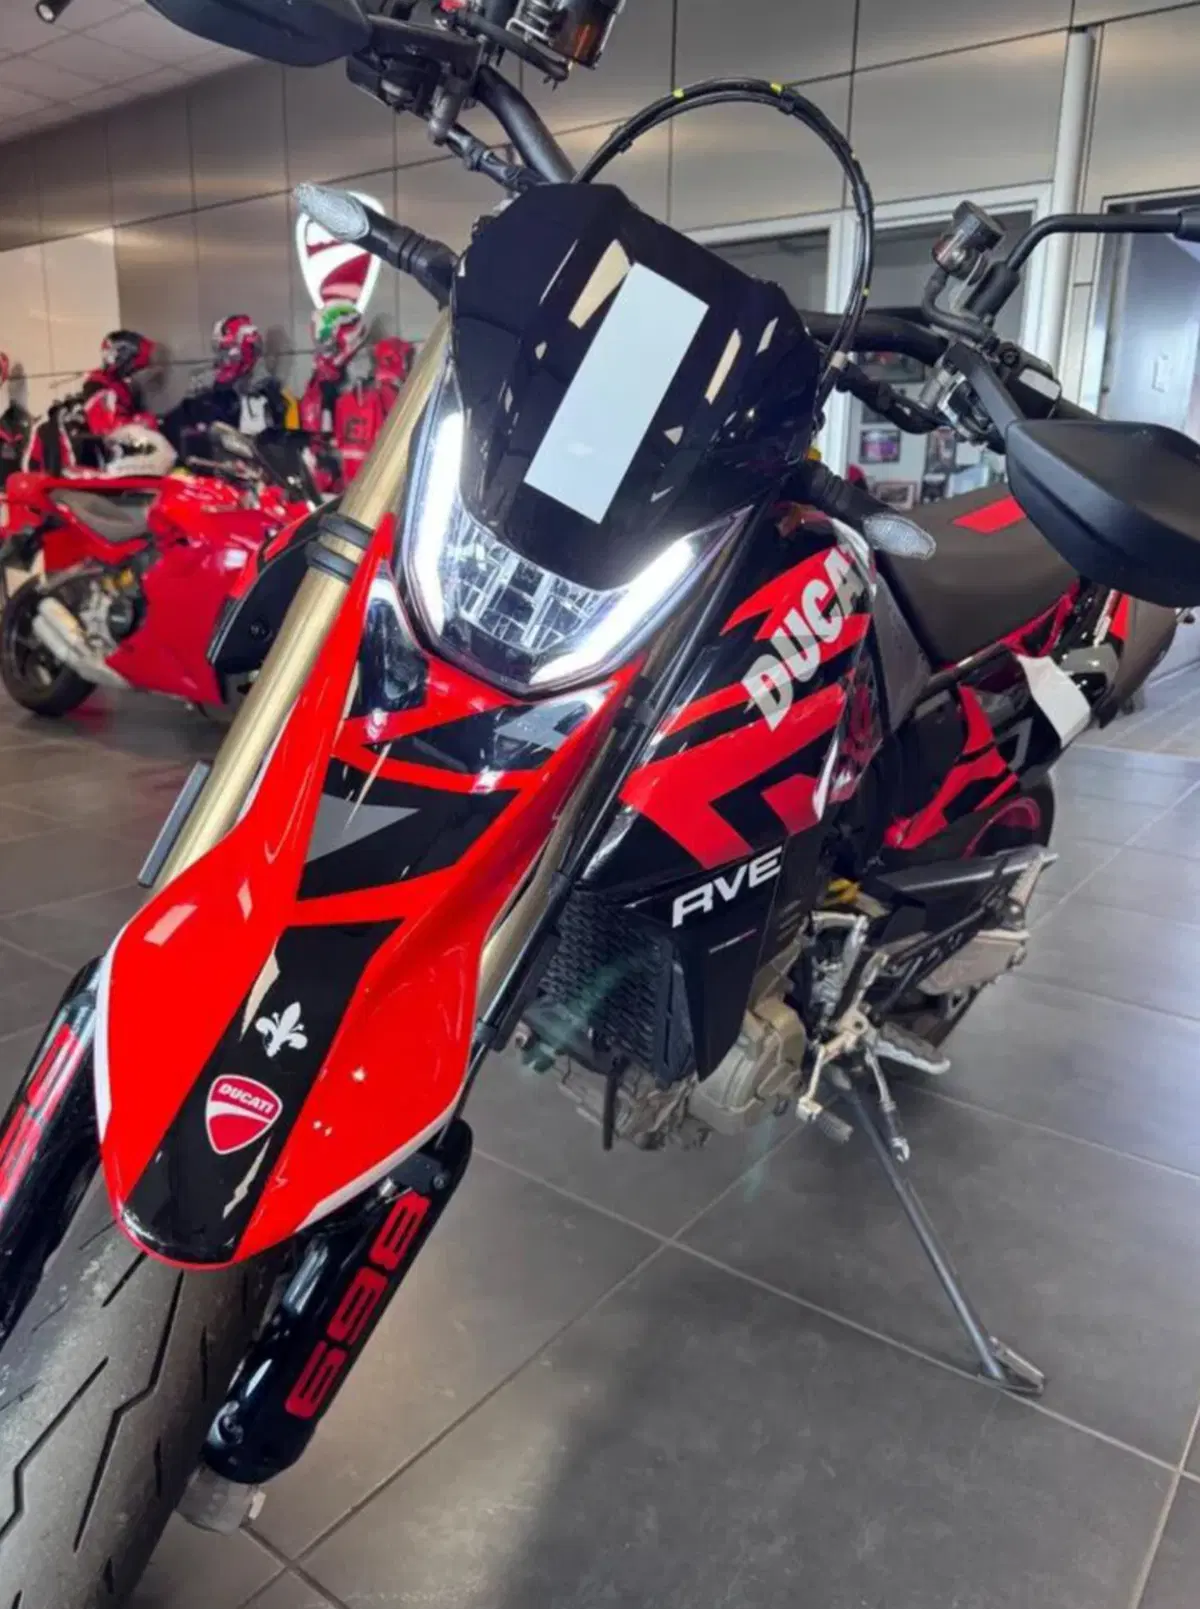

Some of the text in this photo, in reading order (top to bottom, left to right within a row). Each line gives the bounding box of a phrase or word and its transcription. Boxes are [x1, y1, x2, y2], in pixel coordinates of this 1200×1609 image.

[741, 545, 865, 732] DUCA
[218, 1083, 275, 1115] DUCATI
[285, 1191, 431, 1420] 698
